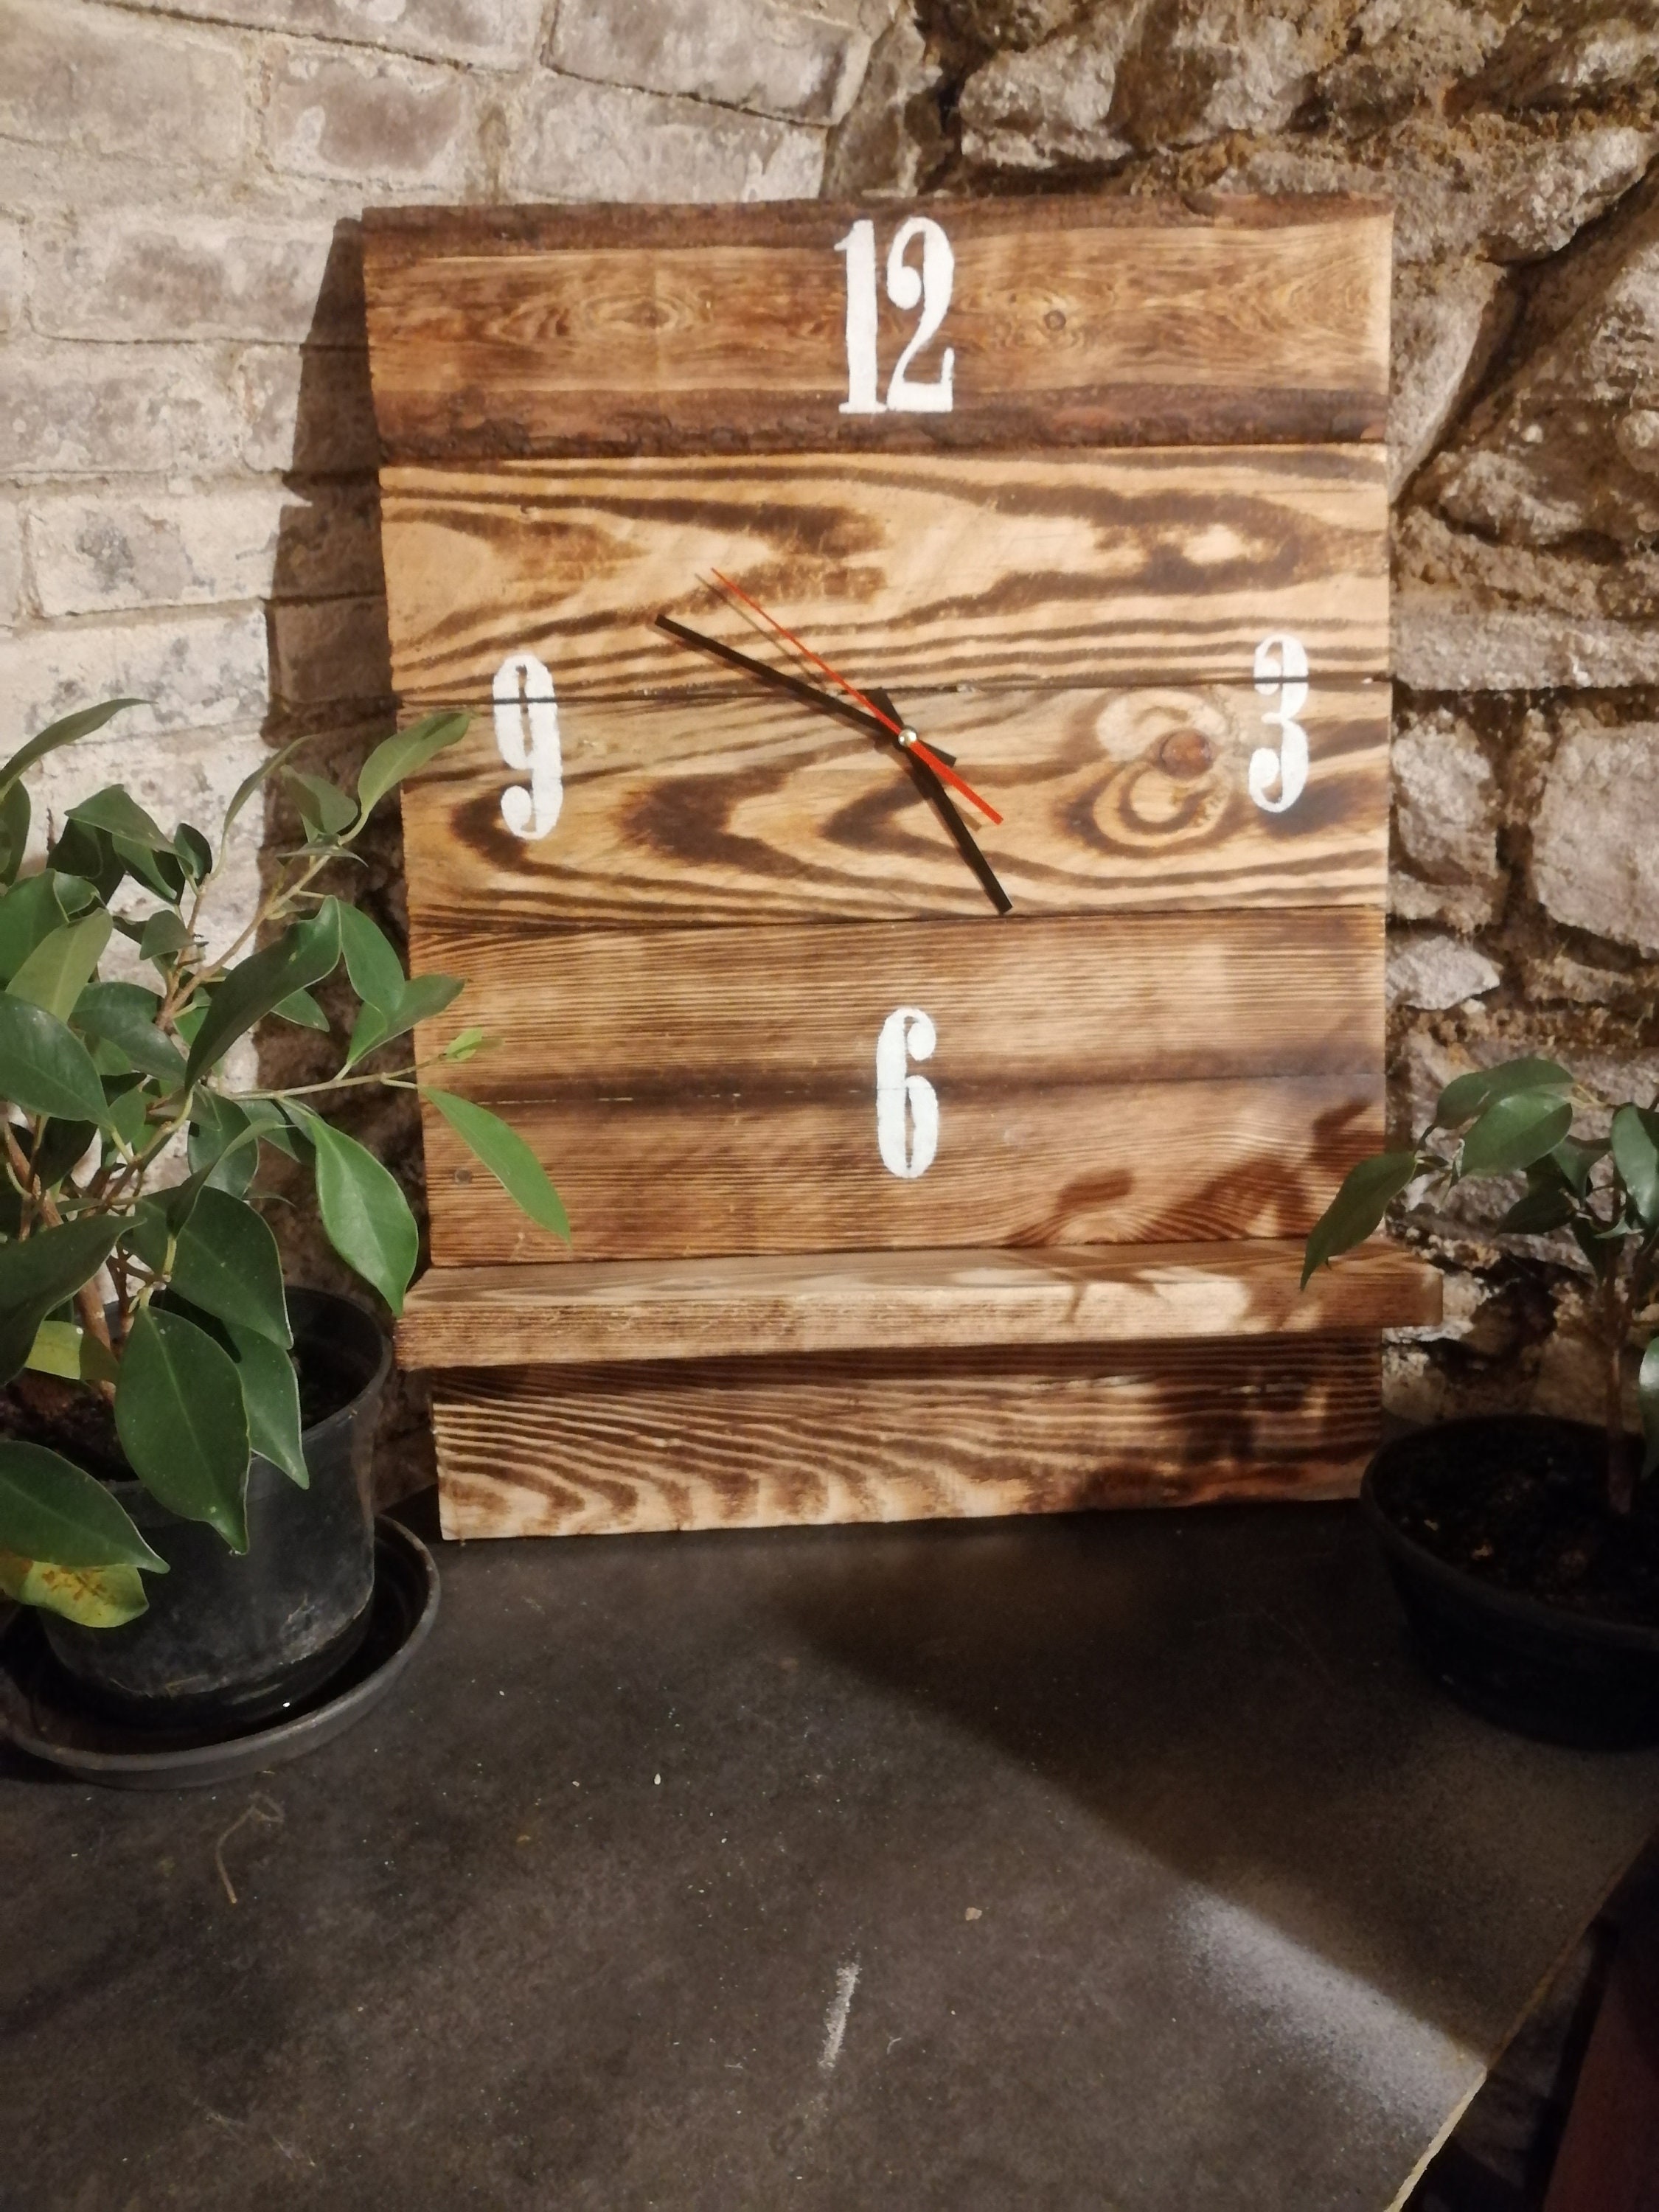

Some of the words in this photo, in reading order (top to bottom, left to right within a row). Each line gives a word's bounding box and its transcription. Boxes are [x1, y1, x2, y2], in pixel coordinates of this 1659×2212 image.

[834, 217, 955, 414] 12
[492, 654, 563, 841] 9
[1248, 634, 1309, 813] 3
[875, 1006, 939, 1179] 6
